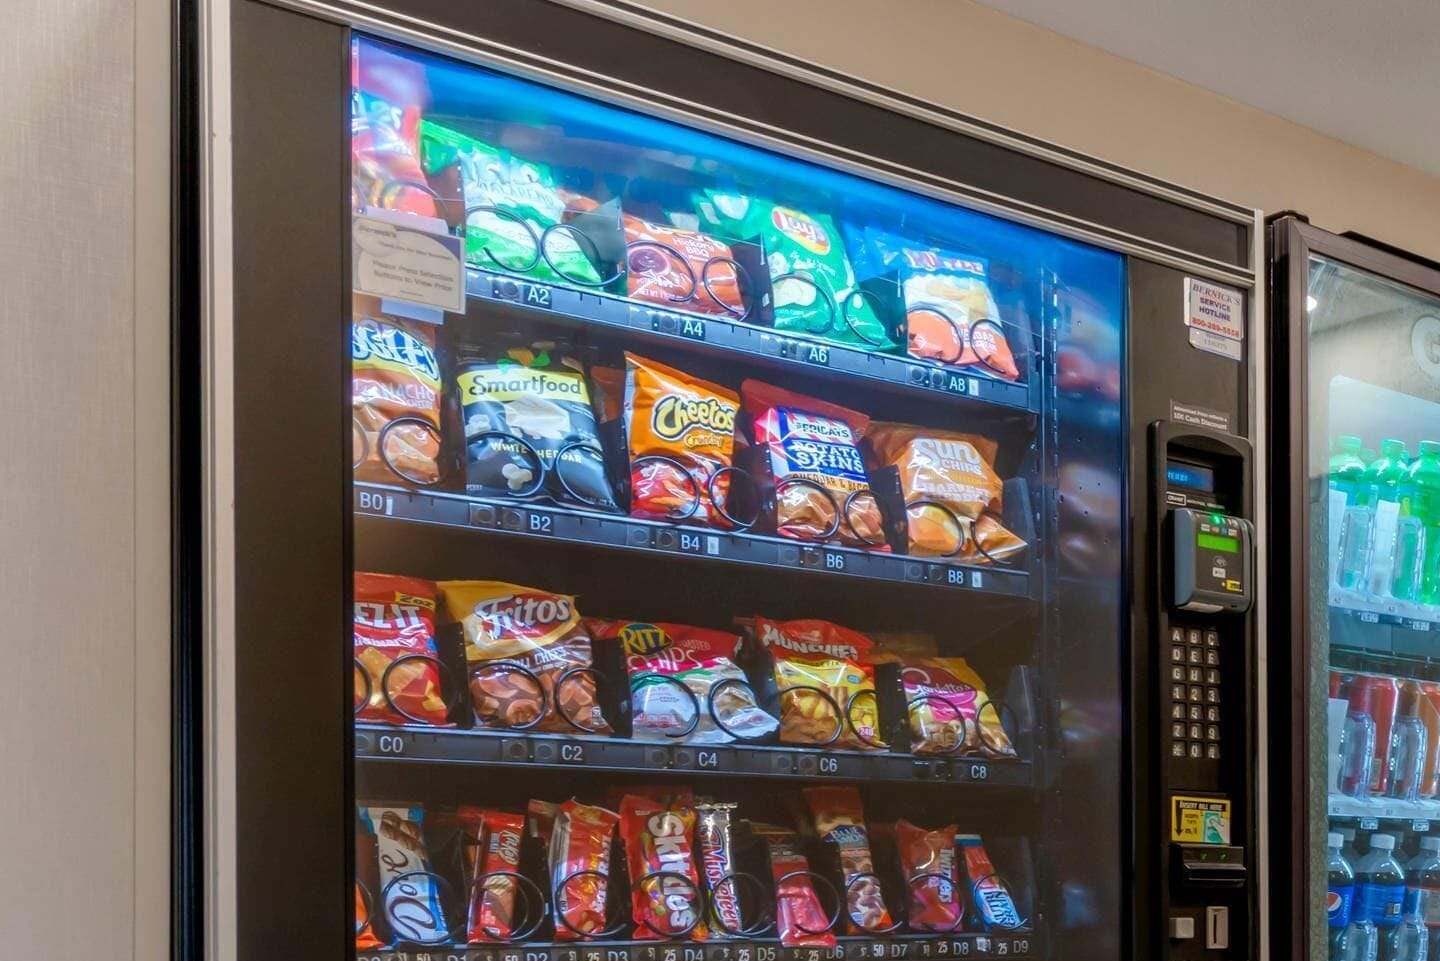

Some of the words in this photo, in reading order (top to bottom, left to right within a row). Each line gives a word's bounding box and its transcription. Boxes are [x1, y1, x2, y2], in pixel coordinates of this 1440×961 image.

[528, 288, 549, 304] A2
[1200, 297, 1231, 312] SERVICE
[1199, 306, 1231, 322] HOTLINE
[683, 321, 703, 336] A4
[809, 348, 827, 363] A6
[469, 375, 581, 396] Smartfood
[950, 378, 966, 392] A8
[655, 396, 735, 438] Cheetos
[797, 452, 865, 474] SKINS
[360, 492, 383, 510] B0
[530, 515, 550, 531] B2
[682, 536, 700, 550] B4
[827, 554, 844, 568] B6
[948, 570, 964, 584] B8
[476, 595, 570, 639] Fritos
[619, 626, 671, 654] RITZ
[380, 736, 403, 752] C0
[562, 745, 582, 761] C2
[698, 752, 717, 766] C4
[820, 758, 837, 772] C6
[971, 765, 987, 779] C8
[1210, 802, 1223, 811] HERE
[757, 947, 776, 961] D5
[892, 944, 908, 957] D7
[953, 943, 969, 956] D8
[1013, 940, 1028, 953] D9
